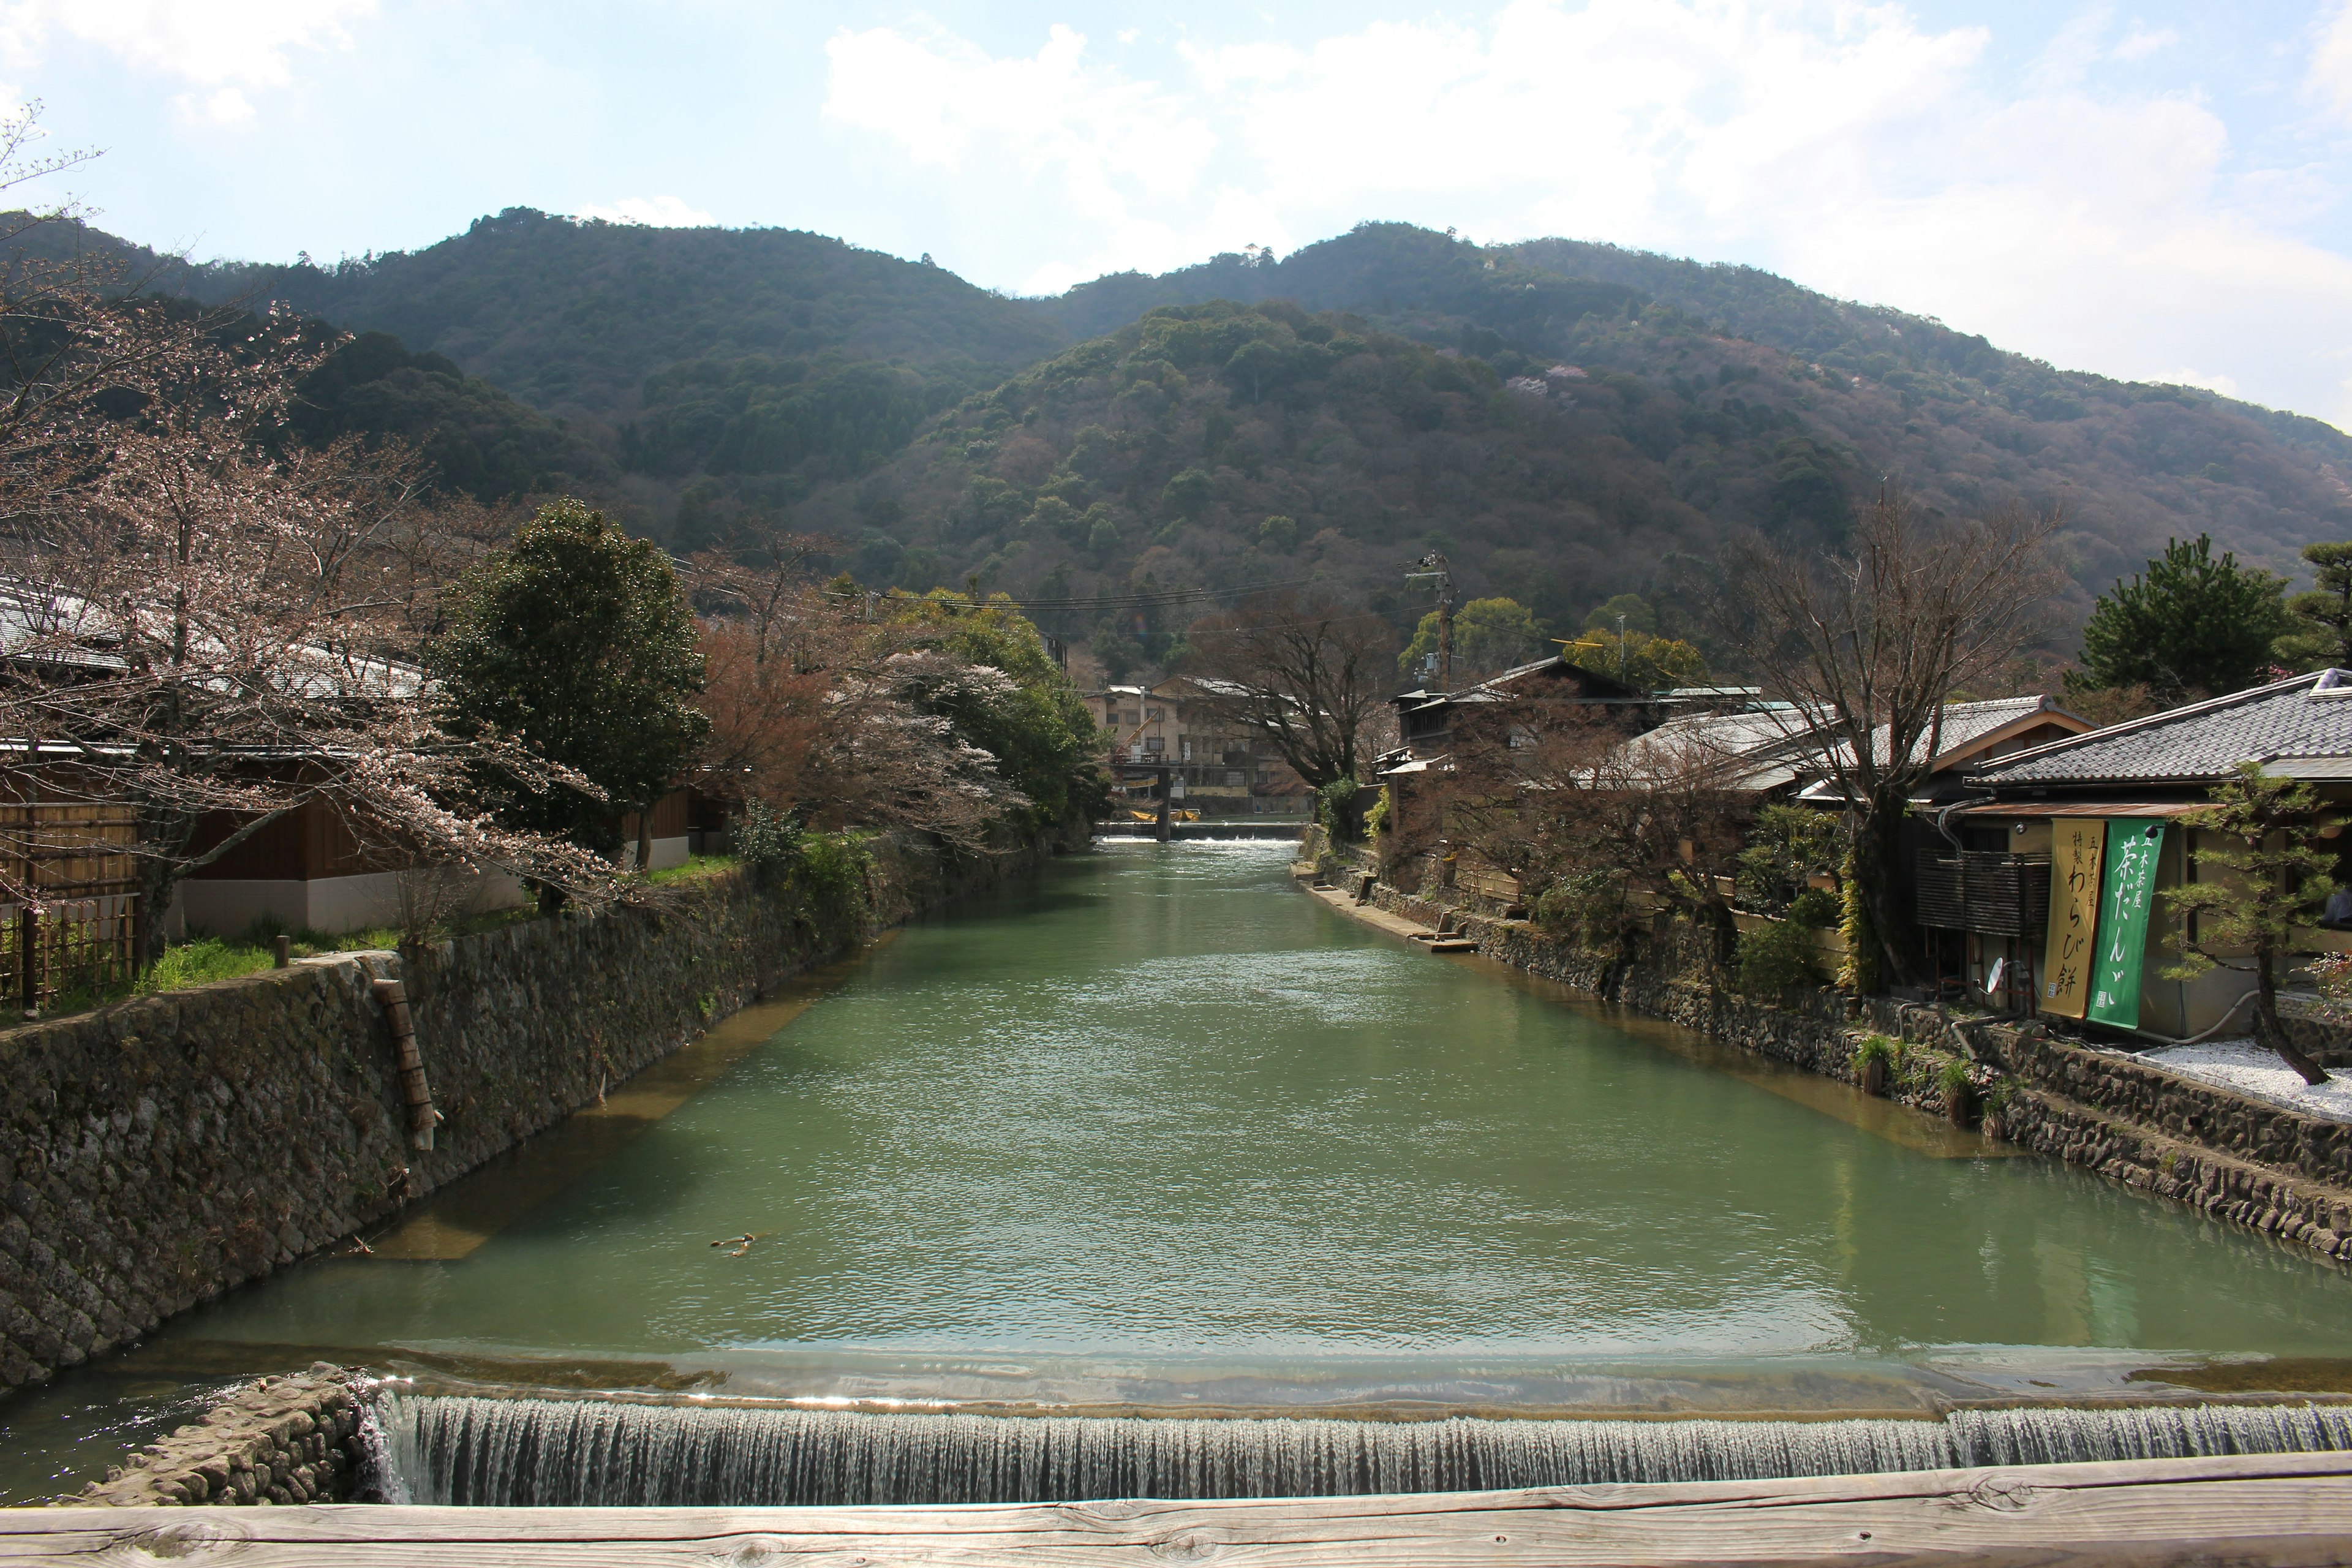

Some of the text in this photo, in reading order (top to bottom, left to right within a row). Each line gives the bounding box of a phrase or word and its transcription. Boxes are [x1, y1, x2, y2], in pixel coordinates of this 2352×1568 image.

[2086, 837, 2098, 907] 五木茶屋
[2109, 835, 2137, 1005] 茶だんご
